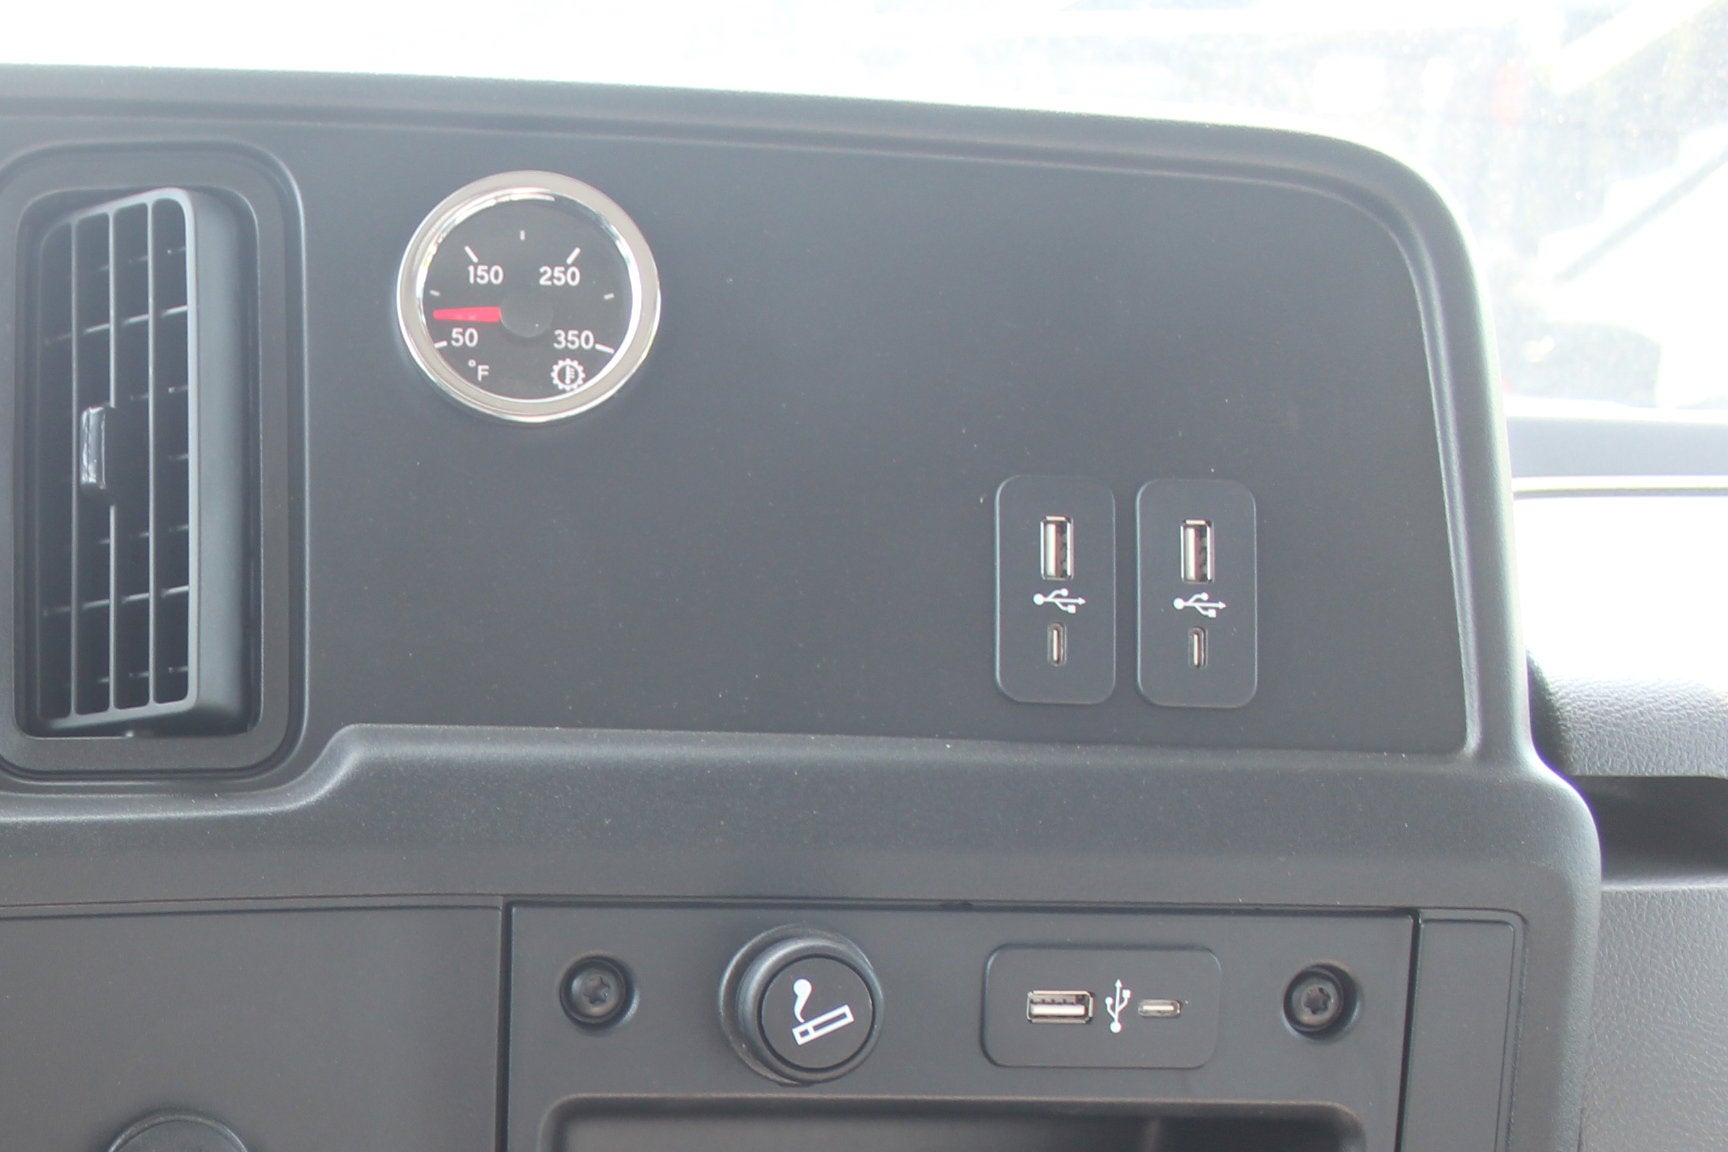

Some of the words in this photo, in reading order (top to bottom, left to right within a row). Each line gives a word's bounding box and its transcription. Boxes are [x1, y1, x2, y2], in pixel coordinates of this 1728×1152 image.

[468, 265, 503, 284] 150
[539, 266, 580, 286] 250
[451, 328, 478, 347] 50
[553, 330, 594, 350] 350
